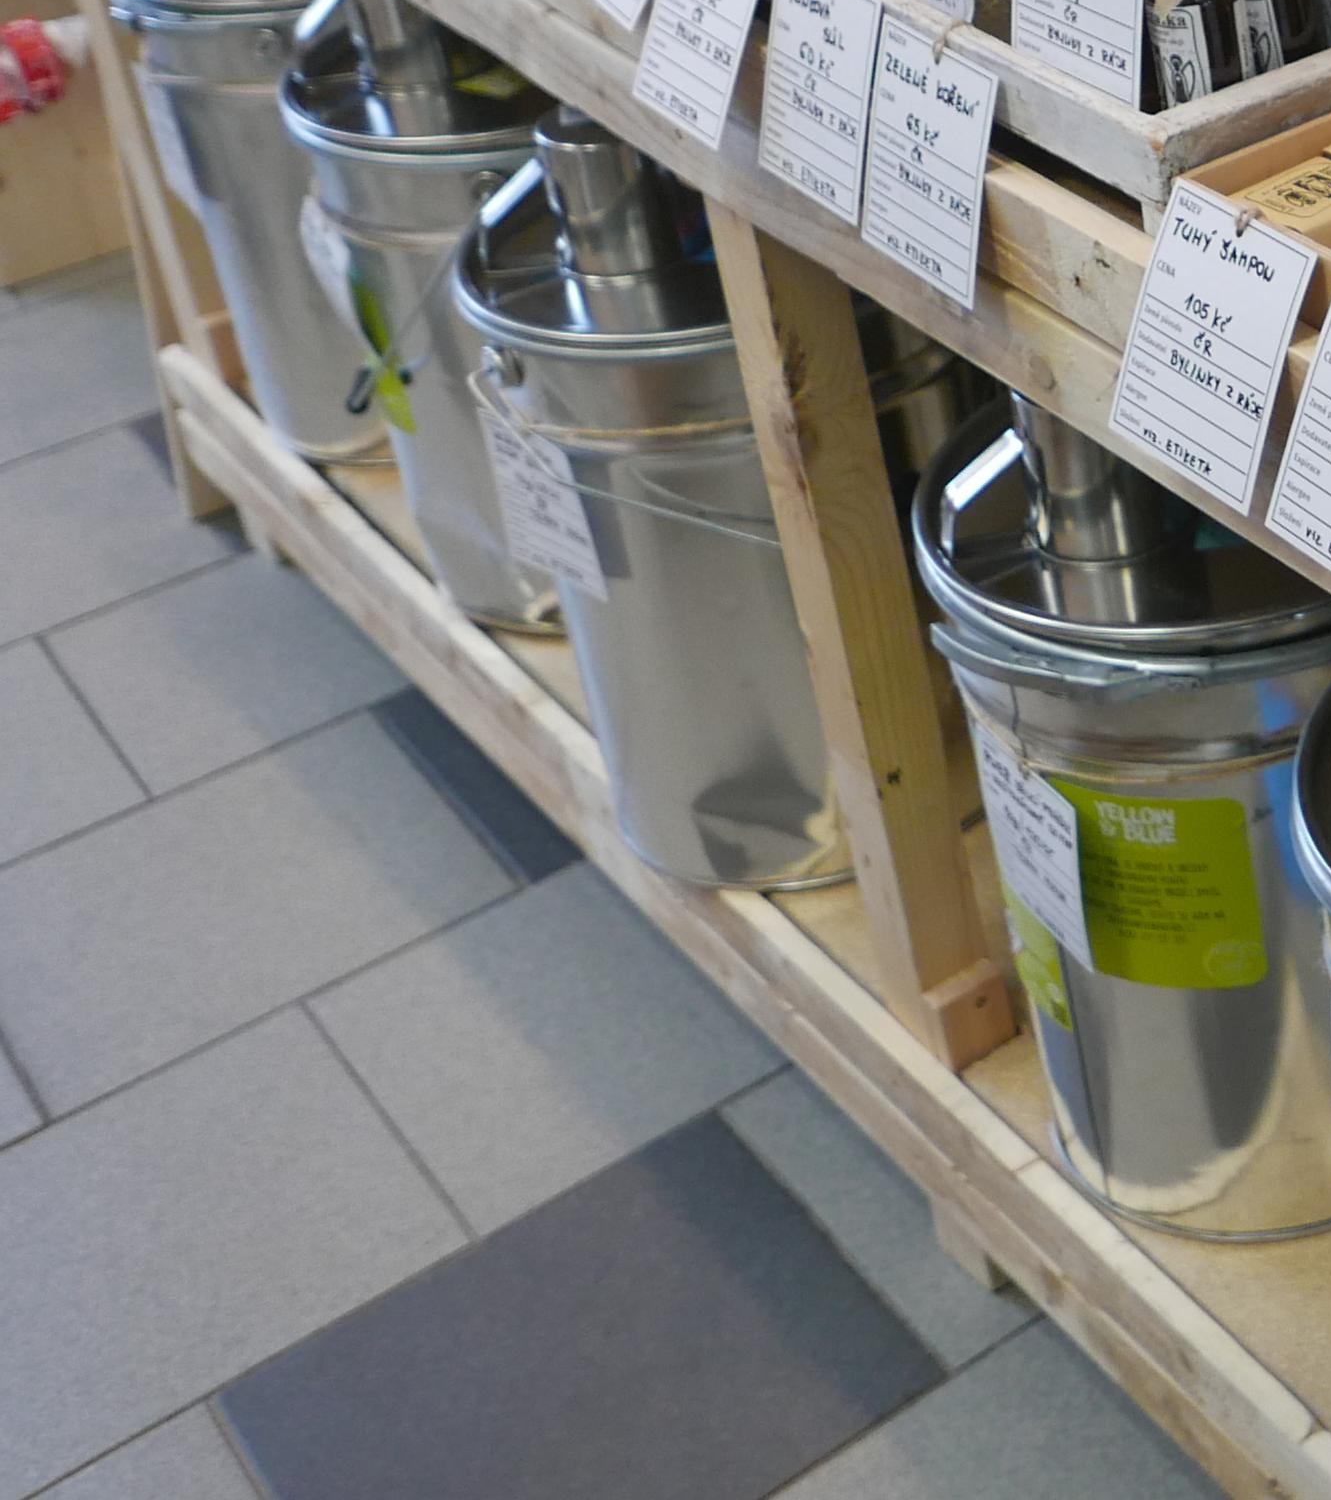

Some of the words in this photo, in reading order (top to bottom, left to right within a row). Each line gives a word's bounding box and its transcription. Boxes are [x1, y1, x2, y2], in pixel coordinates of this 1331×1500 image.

[885, 52, 930, 94] ZELENÉ
[906, 113, 921, 137] 65
[1179, 196, 1203, 215] NÁZEV
[1172, 216, 1218, 252] TUHÝ
[1219, 239, 1275, 283] ŠAMPON
[1155, 260, 1176, 278] CENA
[1184, 294, 1211, 320] 105
[1212, 307, 1233, 334] Kč
[1193, 331, 1213, 358] ČR
[1169, 349, 1221, 395] BYLINKY
[1236, 392, 1264, 420] RÁJE
[1165, 439, 1212, 475] ETIKETA
[1293, 452, 1321, 477] Expirace
[1285, 479, 1311, 503] Alergen
[1094, 801, 1176, 826] YELLOW
[1122, 818, 1178, 846] BLUE
